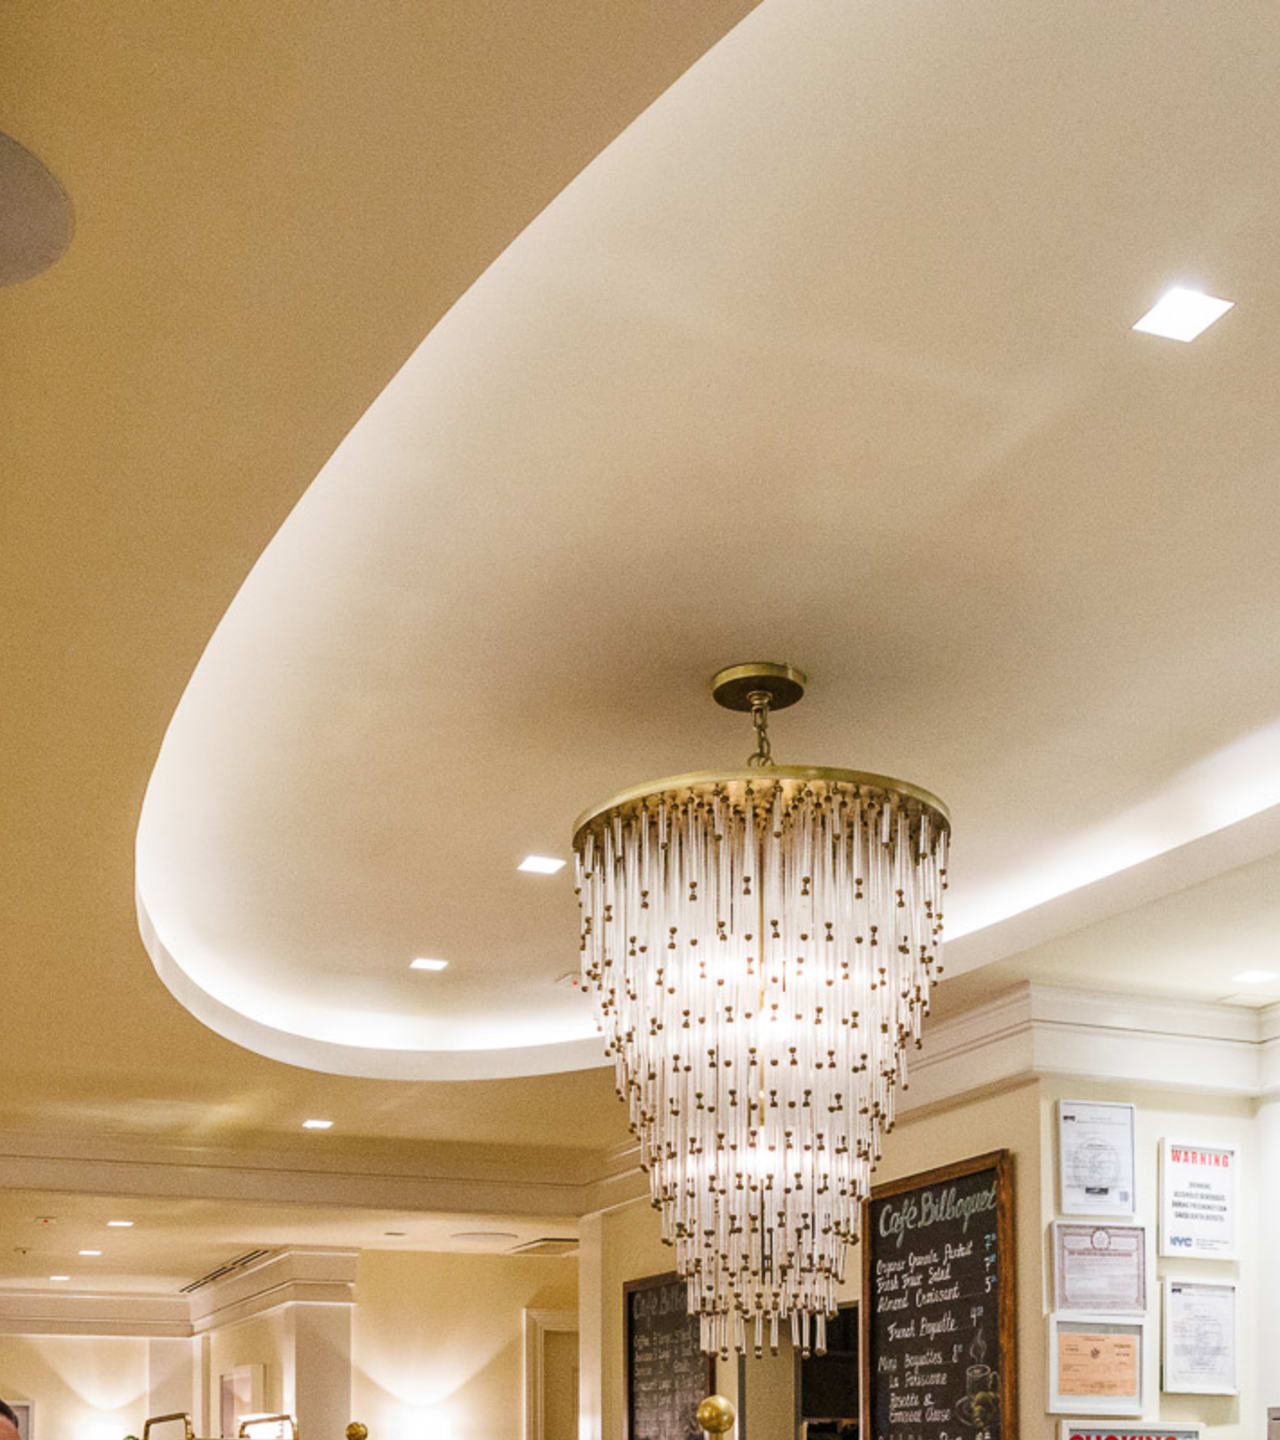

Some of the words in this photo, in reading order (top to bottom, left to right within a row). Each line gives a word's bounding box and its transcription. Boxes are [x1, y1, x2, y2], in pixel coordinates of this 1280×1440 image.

[1170, 1148, 1229, 1168] WARNING
[880, 1197, 918, 1248] Café
[918, 1180, 998, 1233] Bilboquet
[1169, 1236, 1193, 1248] NYC
